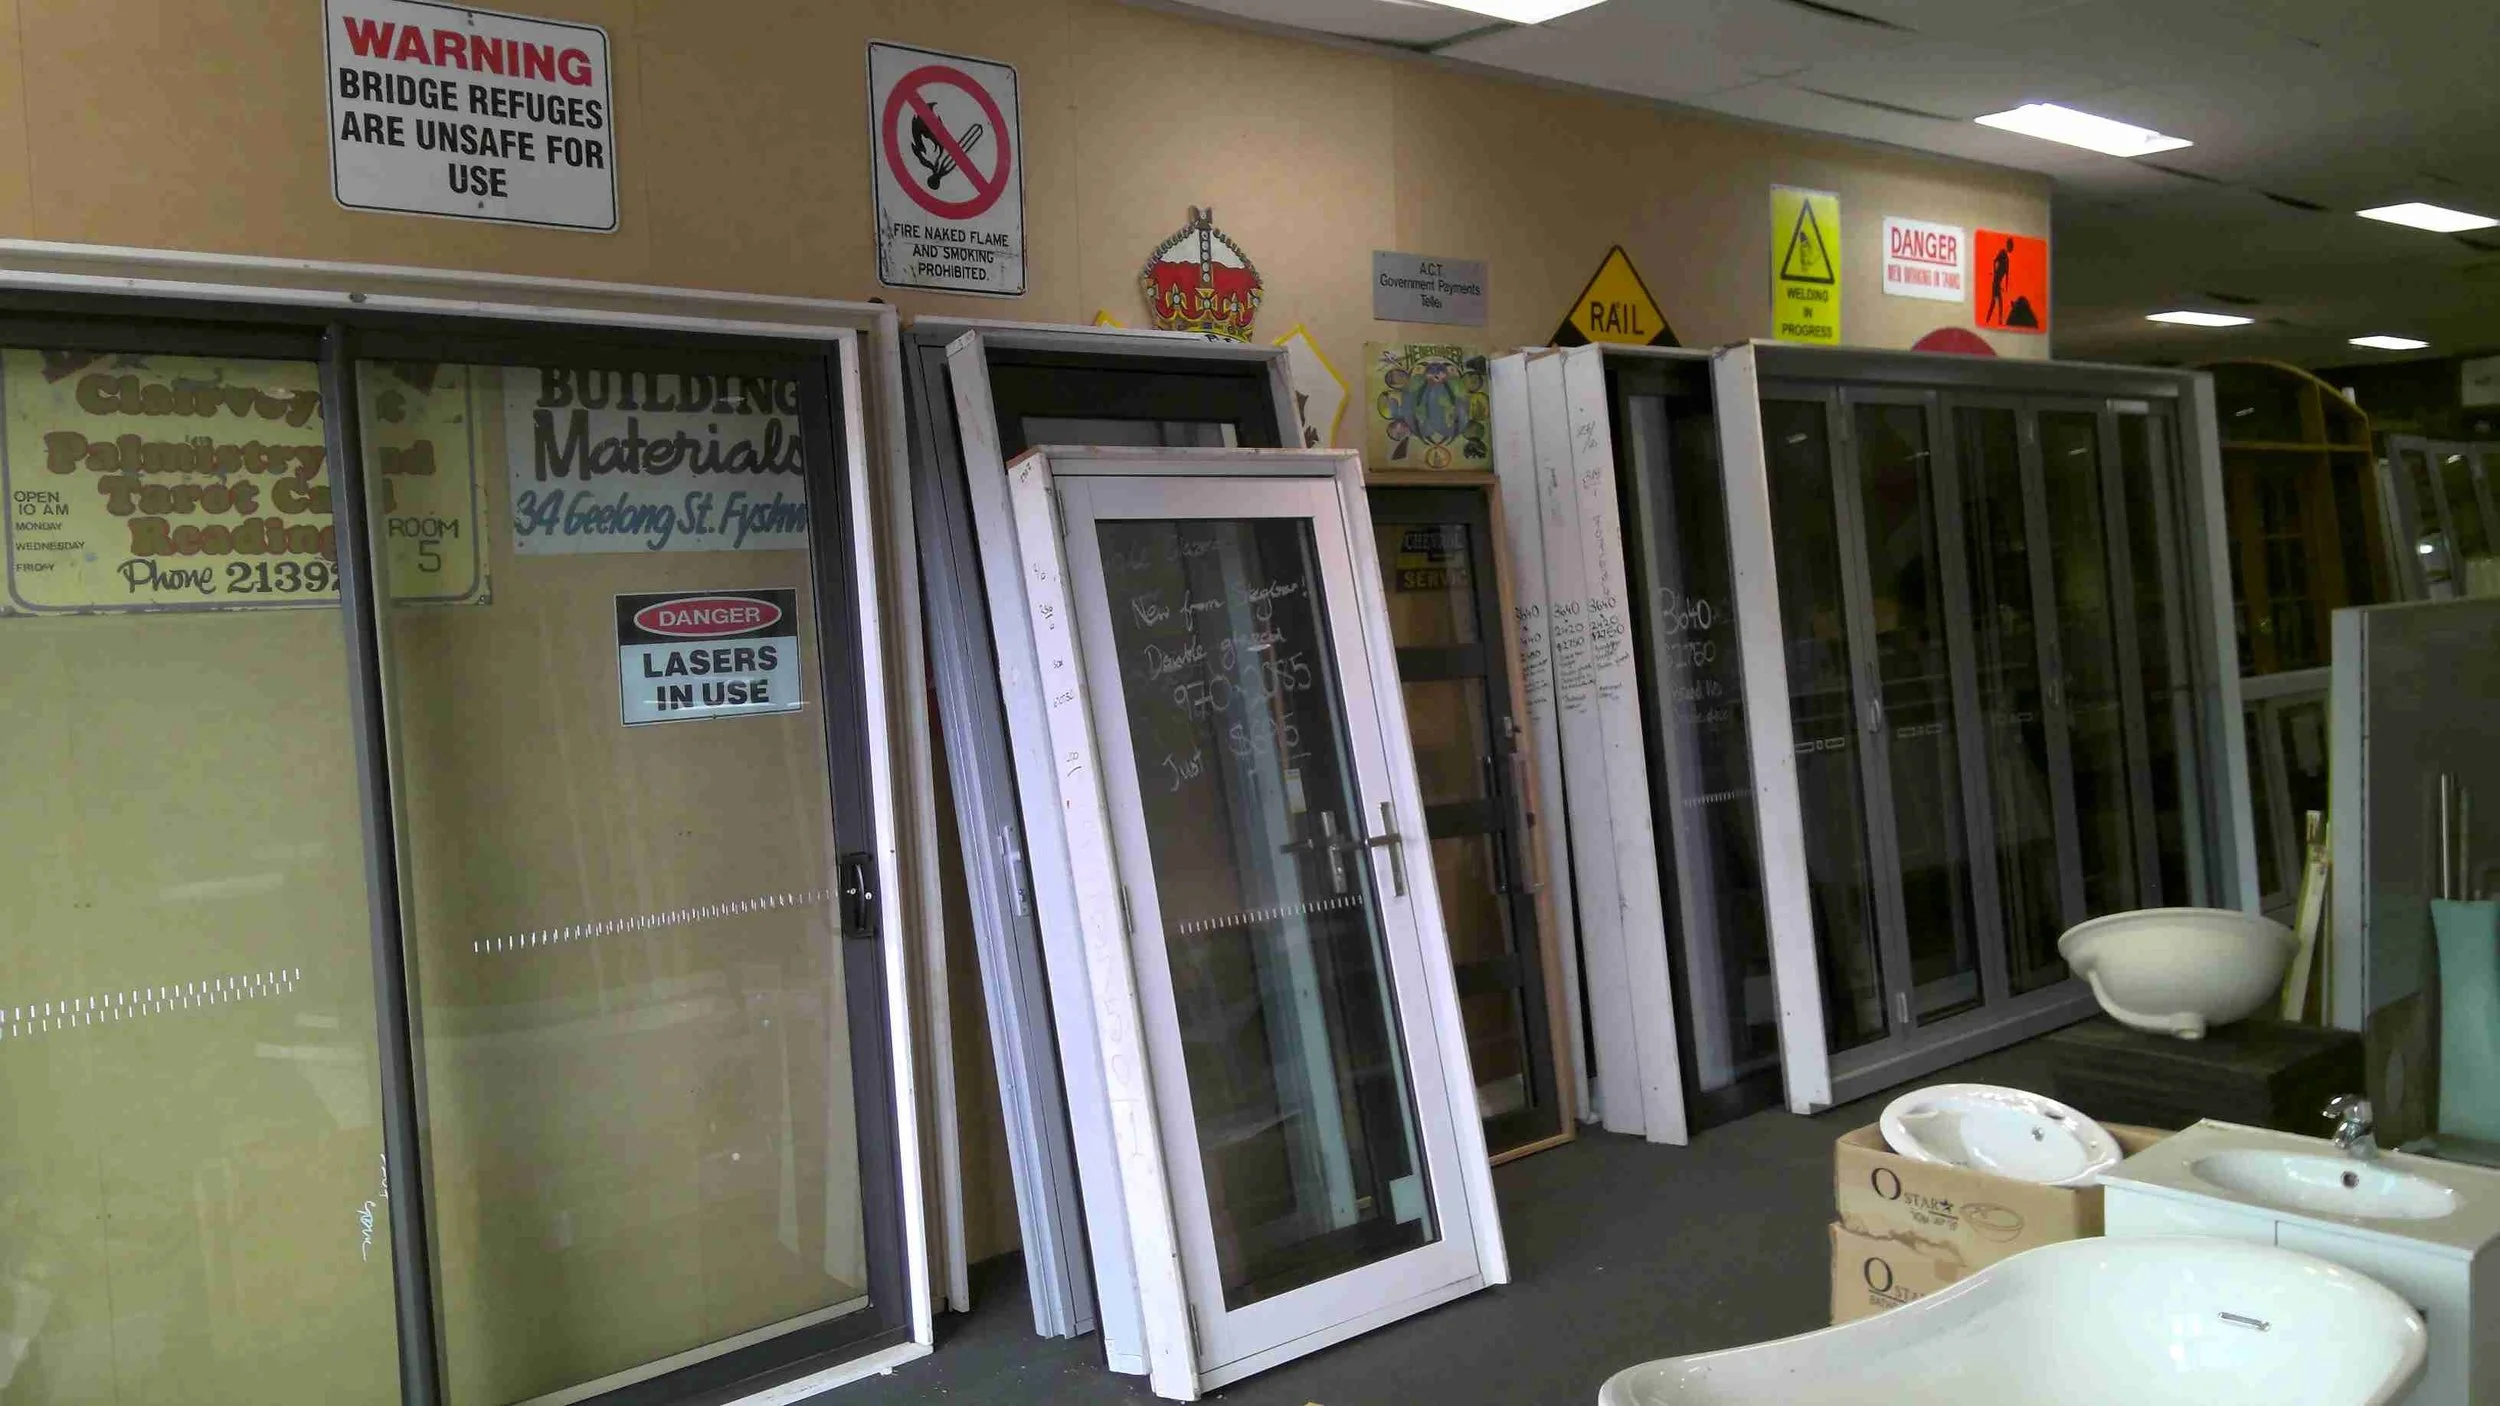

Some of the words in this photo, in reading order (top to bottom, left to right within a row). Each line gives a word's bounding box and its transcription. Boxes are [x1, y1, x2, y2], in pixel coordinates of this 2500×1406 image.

[343, 16, 593, 87] WARNING
[339, 67, 459, 111] BRIDGE
[469, 84, 604, 130] REFUGES
[341, 111, 405, 147] ARE
[416, 119, 535, 162] UNSAFE
[546, 135, 604, 169] FOR
[449, 163, 508, 198] USE
[893, 223, 920, 239] FIRE
[925, 226, 966, 243] NAKED
[970, 231, 1009, 247] FLAME
[1891, 227, 1957, 262] DANGER
[913, 244, 938, 258] AND
[943, 246, 994, 263] SMOKING
[1380, 273, 1435, 291] Government
[1438, 280, 1480, 295] Payments
[1787, 287, 1829, 302] WELDING
[1590, 302, 1644, 335] RAIL
[1803, 308, 1813, 317] IN
[1782, 323, 1833, 338] PROGRESS
[536, 367, 799, 415] BUILDING
[44, 431, 326, 480] Palmistry
[533, 409, 804, 481] Materials
[14, 490, 60, 503] OPEN
[43, 503, 70, 515] AM
[98, 475, 260, 516] Tarot
[16, 521, 63, 530] MONDAY
[388, 517, 459, 539] ROOM
[514, 489, 565, 536] 34
[564, 490, 678, 550] Geelong
[16, 540, 86, 551] WEDNESDAY
[416, 540, 442, 573] 5
[16, 563, 55, 572] FRIDAY
[117, 559, 217, 594] Phone
[659, 607, 760, 628] DANGER
[643, 645, 778, 678] LASERS
[656, 684, 694, 711] IN
[703, 679, 769, 708] USE
